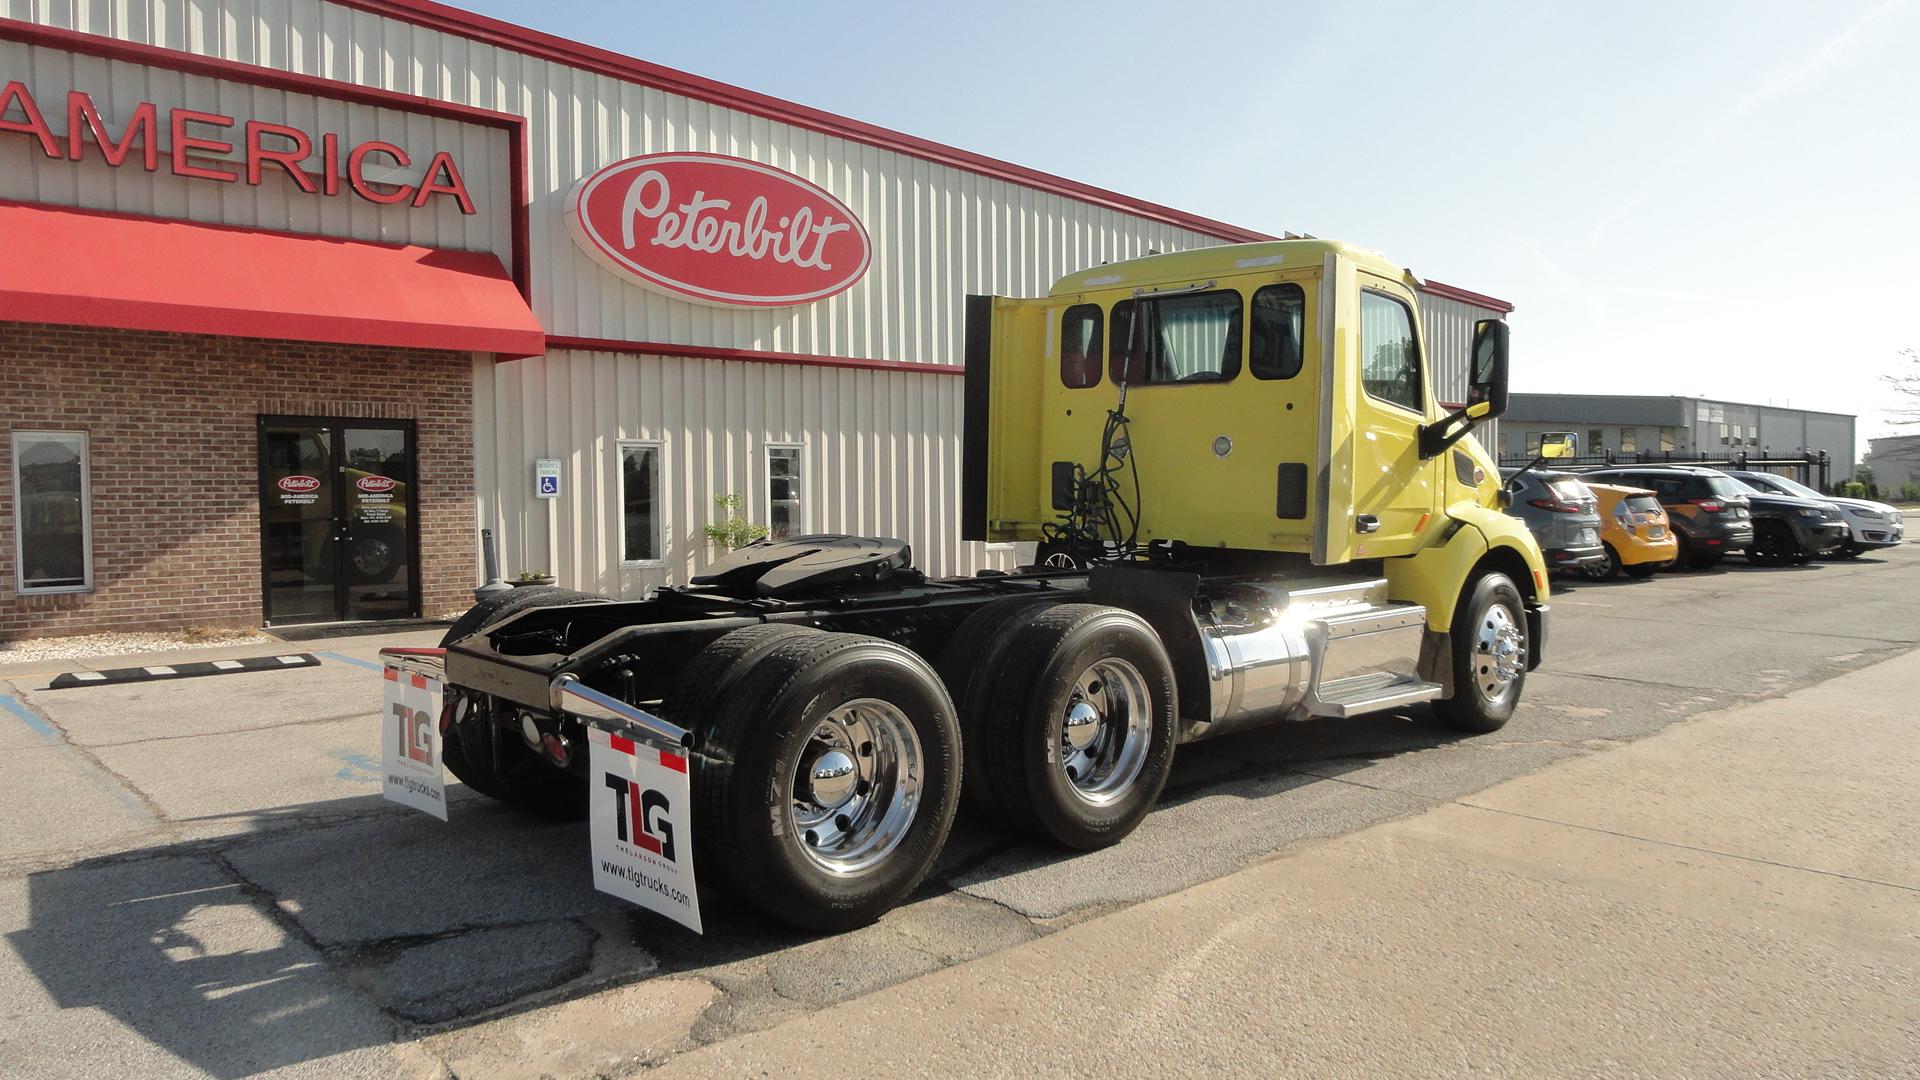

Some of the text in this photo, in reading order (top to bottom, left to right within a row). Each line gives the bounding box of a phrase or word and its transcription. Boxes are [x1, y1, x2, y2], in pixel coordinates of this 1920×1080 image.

[0, 80, 477, 216] AMERICA
[621, 169, 850, 271] Peterbilt
[283, 478, 315, 488] Peterbilt
[361, 478, 391, 488] Peterbilt
[393, 702, 433, 768] TLG
[388, 775, 441, 801] www.tlgtrucks.com
[605, 771, 676, 863] TLG
[601, 859, 691, 908] www.tlgtrucks.com
